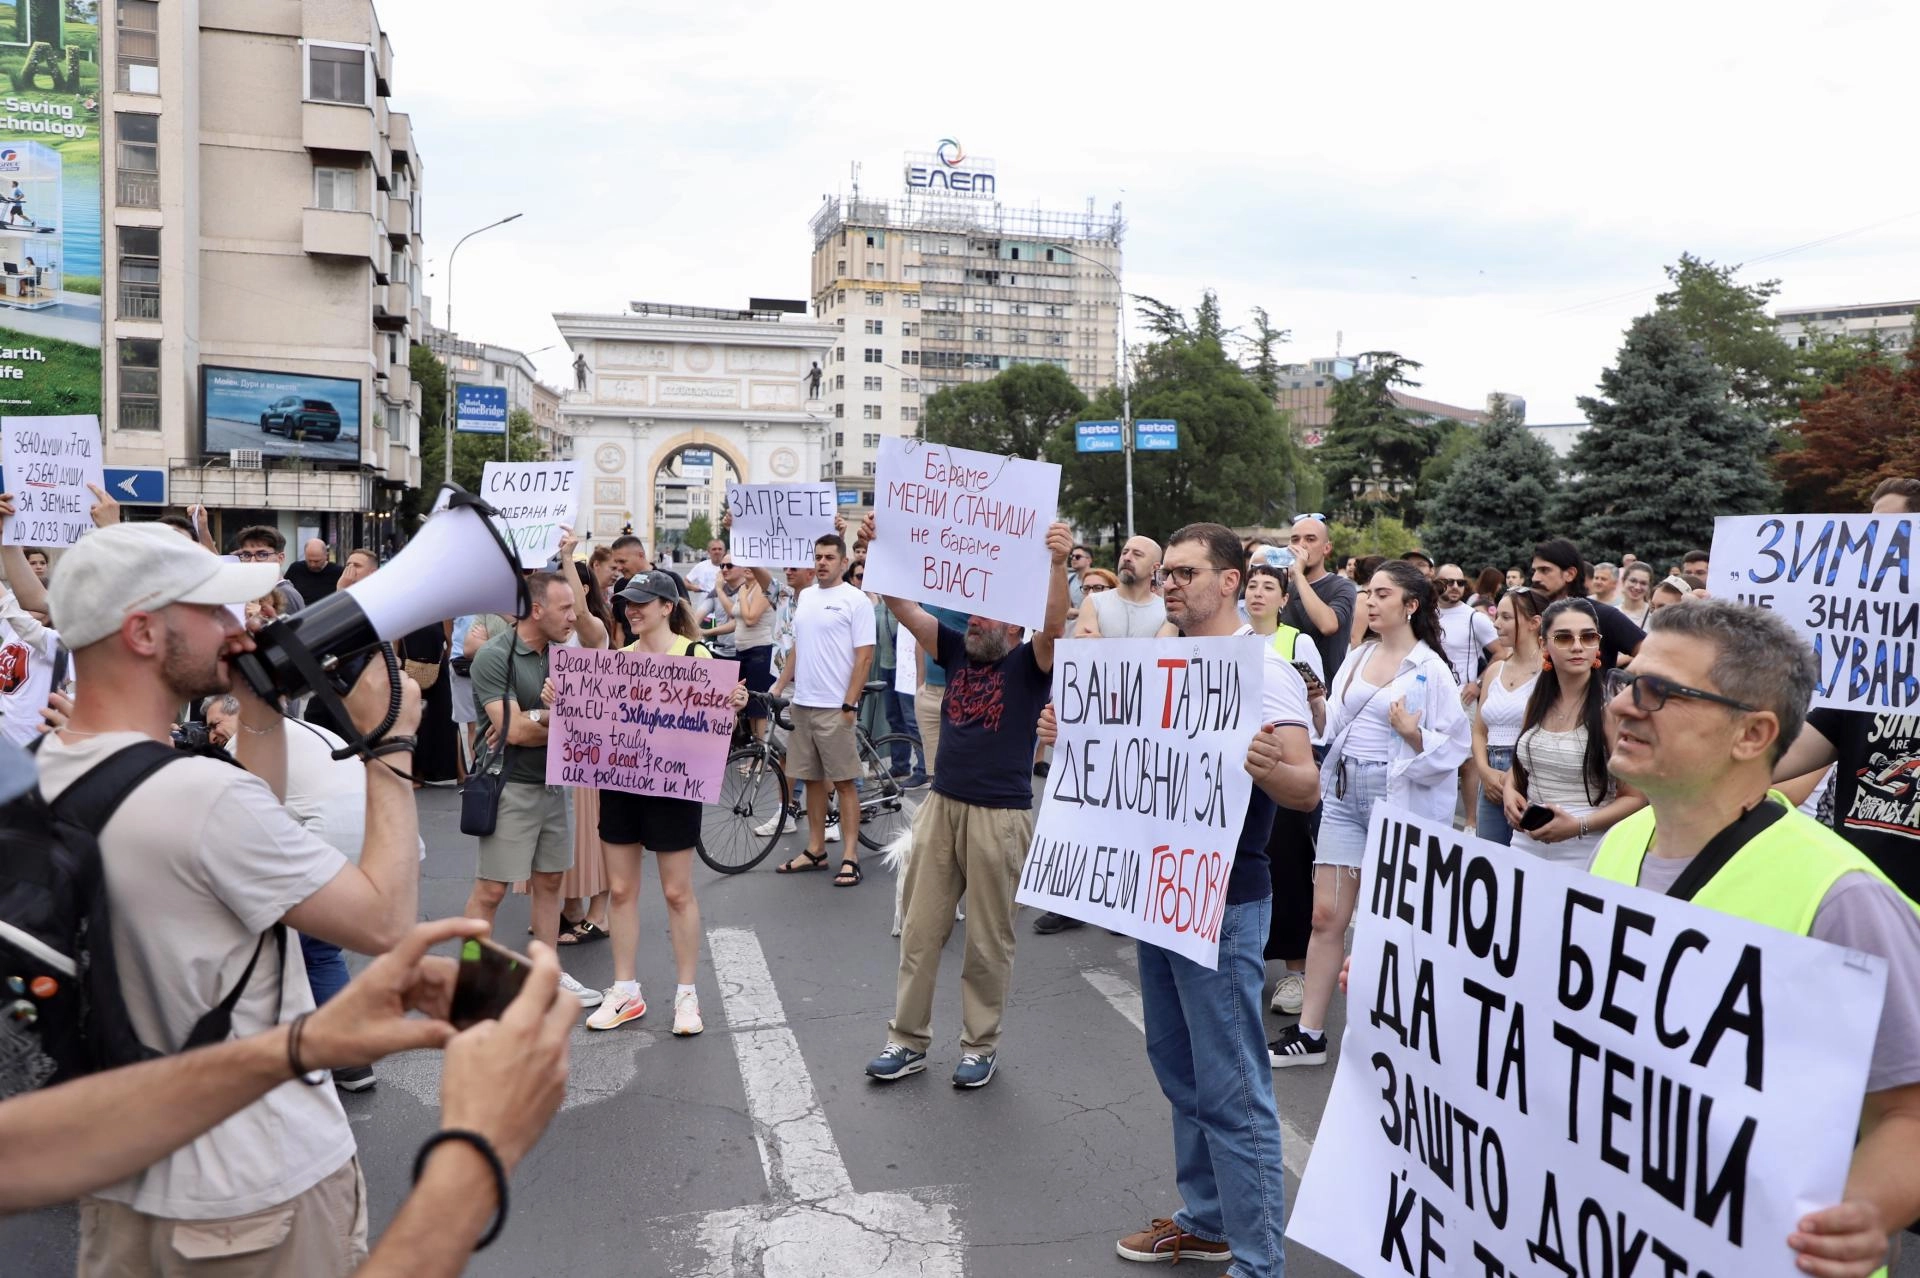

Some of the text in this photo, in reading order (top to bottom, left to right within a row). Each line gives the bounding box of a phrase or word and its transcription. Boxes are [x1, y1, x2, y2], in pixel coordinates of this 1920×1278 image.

[906, 167, 995, 193] ЕЛЕМ
[0, 346, 46, 362] arth,
[0, 365, 24, 379] ife
[458, 402, 505, 418] StoneBridge
[1079, 425, 1119, 435] setec
[1138, 423, 1175, 433] setec
[14, 431, 41, 455] 3640
[26, 462, 60, 486] 25640
[60, 467, 84, 490] ДУШИ
[490, 471, 574, 493] СКОПЈЕ
[925, 452, 988, 490] Бараме
[19, 491, 81, 514] ЗА ЗЕМАЊЕ
[552, 503, 567, 516] НА
[731, 489, 832, 518] ЗАПРЕТЕ
[888, 481, 1036, 540] МЕРНИ СТАНИЦИ
[14, 523, 26, 541] ДО
[31, 521, 59, 544] 2033
[765, 516, 788, 537] ЈА
[733, 537, 816, 561] ЦЕМЕНТА
[911, 526, 1001, 560] не бараме
[923, 556, 993, 602] ВЛАСТ
[1805, 593, 1919, 640] ЗНАЧИ
[630, 680, 653, 704] die
[1060, 658, 1142, 727] ВАШИ
[1157, 657, 1241, 739] ТАЈНИ
[556, 698, 584, 718] than
[677, 708, 709, 732] death
[562, 744, 600, 765] 3640
[608, 742, 639, 769] dead
[1888, 739, 1911, 751] ARE
[662, 777, 678, 793] in
[1194, 751, 1227, 828] ЗА
[1023, 834, 1230, 944] НАШИ БЕЛИ ГРОБОВИ
[1371, 817, 1764, 1092] НЕМОЈ БЕСА
[1370, 938, 1758, 1248] ДА ТА ТЕШИ
[1371, 1051, 1508, 1231] ЗАШТО
